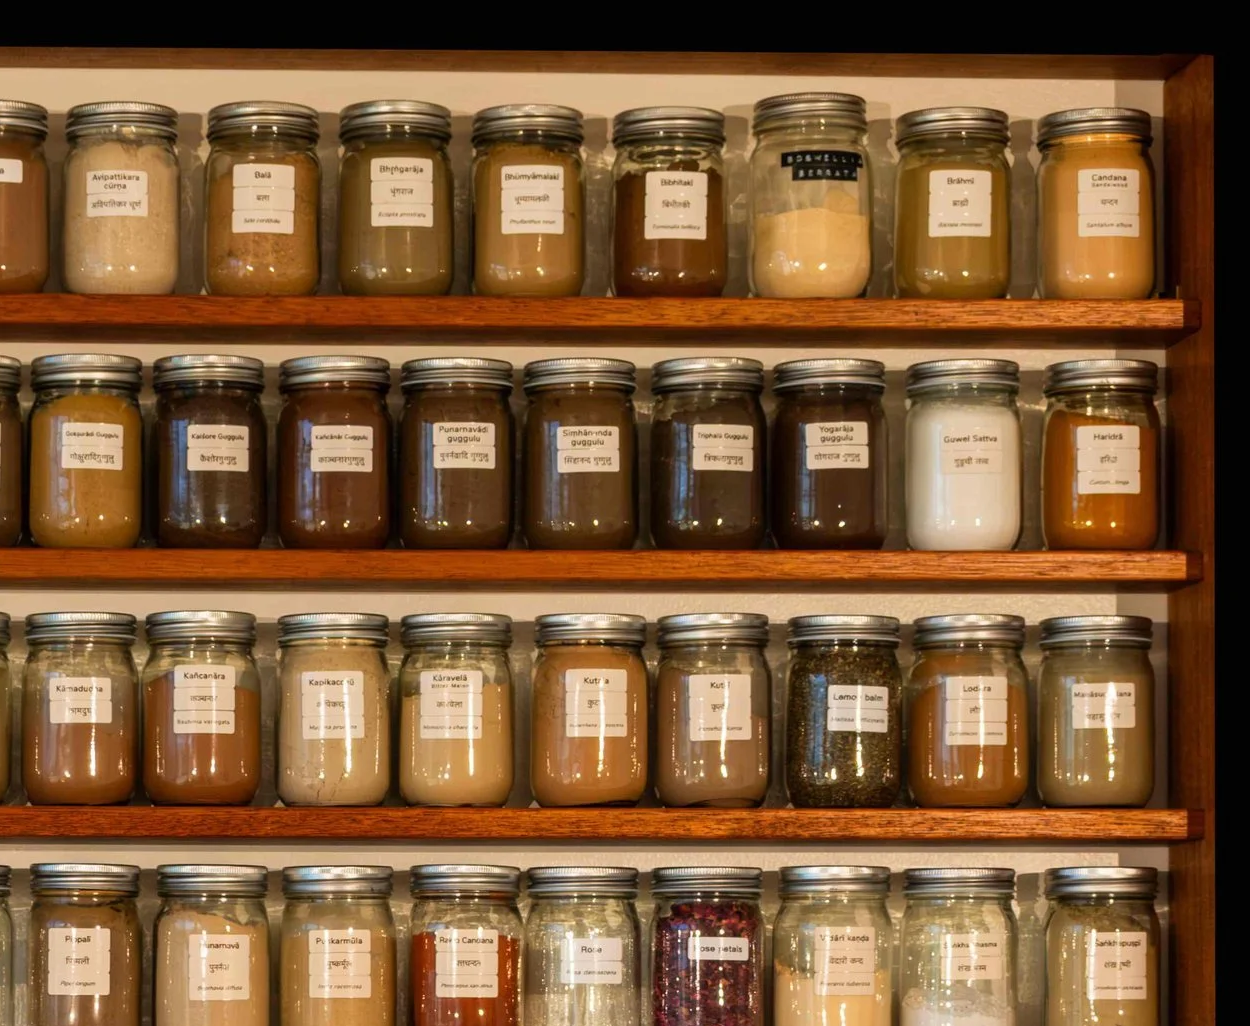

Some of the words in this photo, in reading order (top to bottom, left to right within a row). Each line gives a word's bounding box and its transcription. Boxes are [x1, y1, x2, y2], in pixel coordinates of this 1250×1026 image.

[92, 174, 139, 182] Avipattikara
[255, 171, 271, 179] Balā
[819, 426, 854, 434] Yogarāja
[218, 433, 244, 441] Guggulu
[820, 434, 853, 443] guggulu
